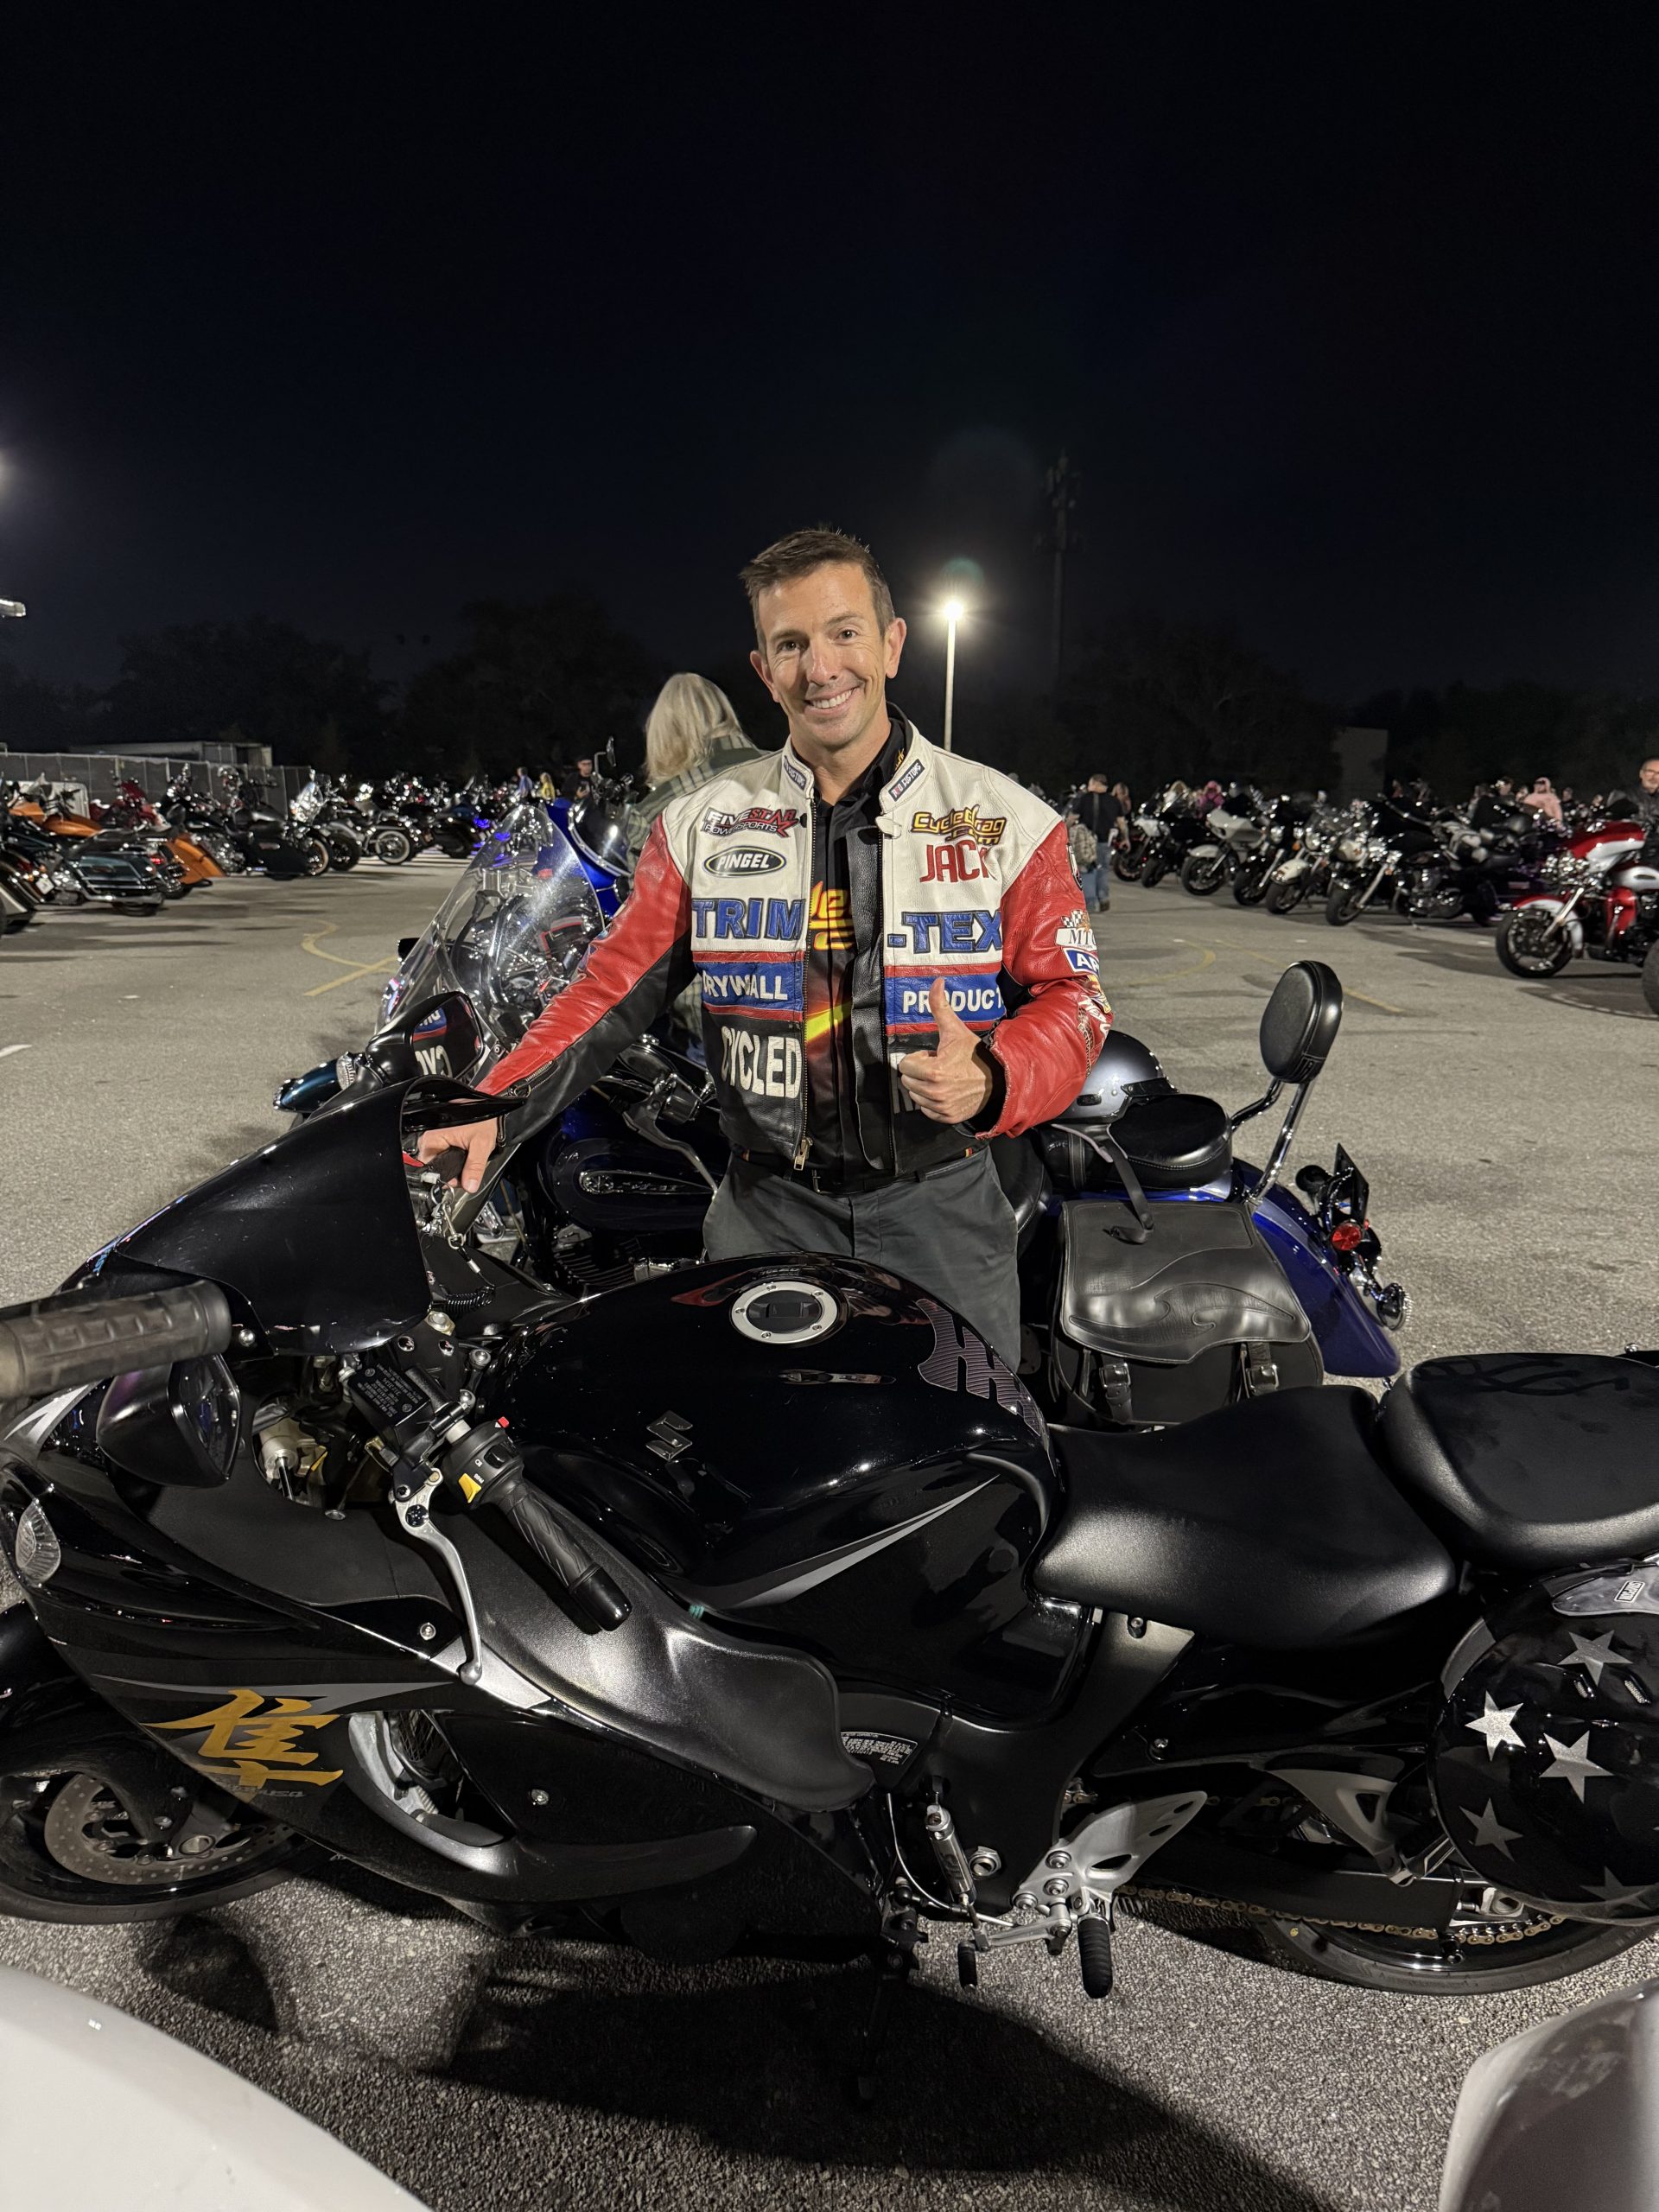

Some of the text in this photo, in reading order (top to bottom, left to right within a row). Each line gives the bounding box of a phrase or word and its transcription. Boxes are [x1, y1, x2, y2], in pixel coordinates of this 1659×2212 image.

[716, 854, 770, 870] PINGEL
[692, 898, 805, 941] TRIM
[721, 1026, 803, 1099] CYCLED
